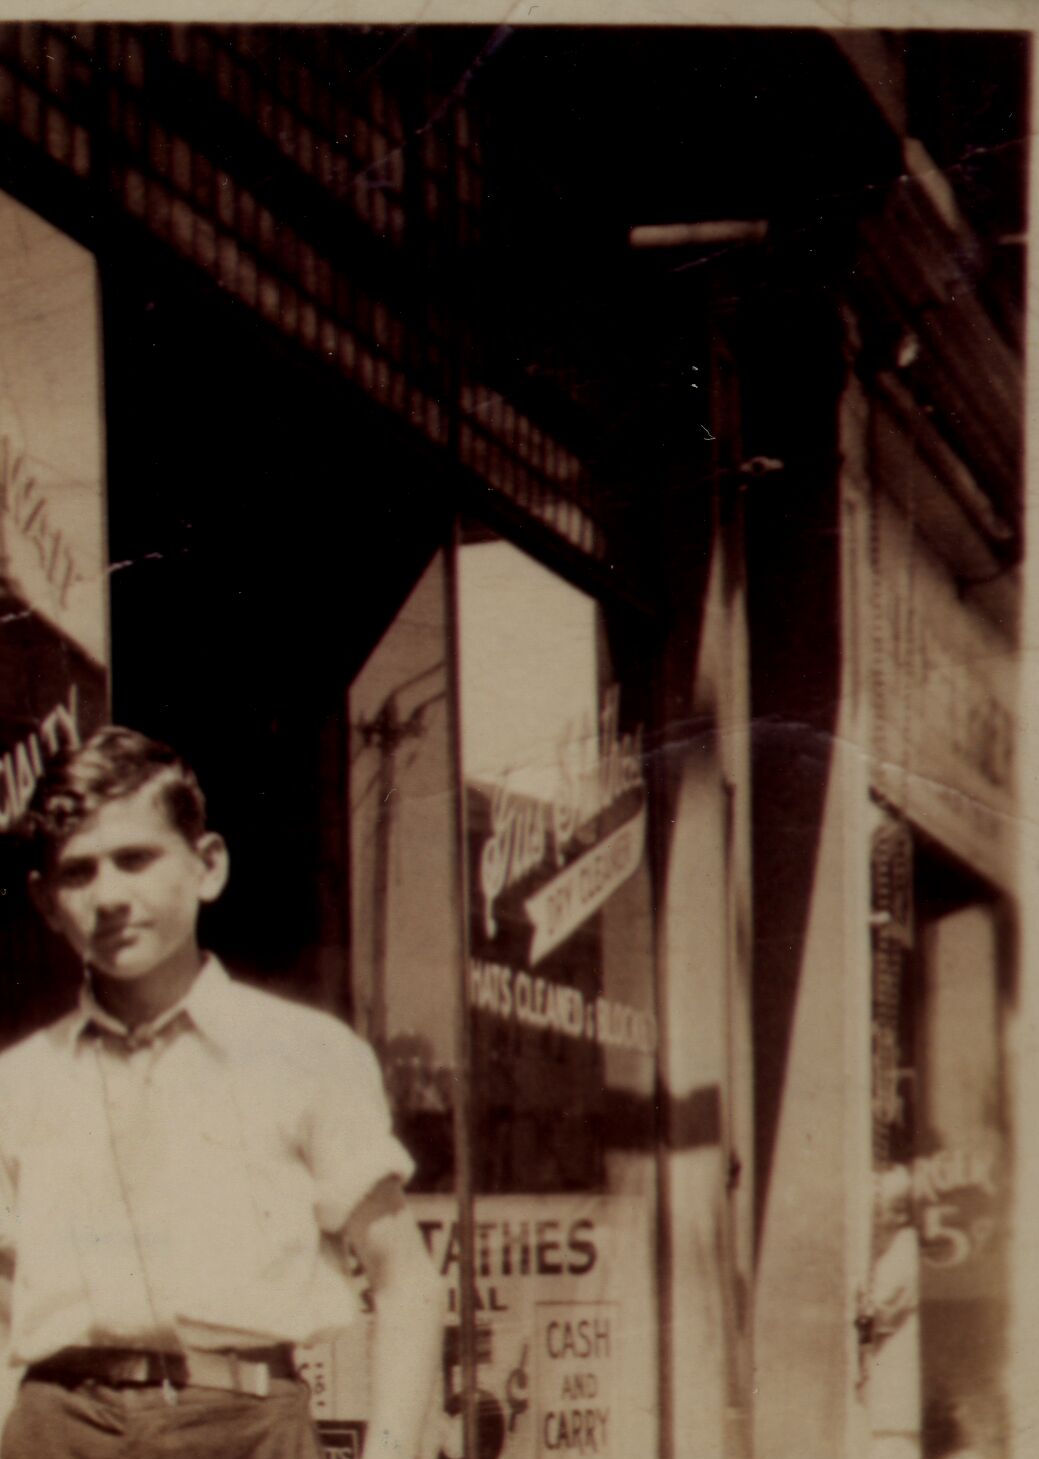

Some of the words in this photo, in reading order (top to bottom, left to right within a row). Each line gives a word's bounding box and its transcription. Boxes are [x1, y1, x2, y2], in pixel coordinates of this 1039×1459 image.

[545, 1318, 610, 1360] CASH
[561, 1372, 598, 1400] AND
[543, 1406, 610, 1456] CARRY
